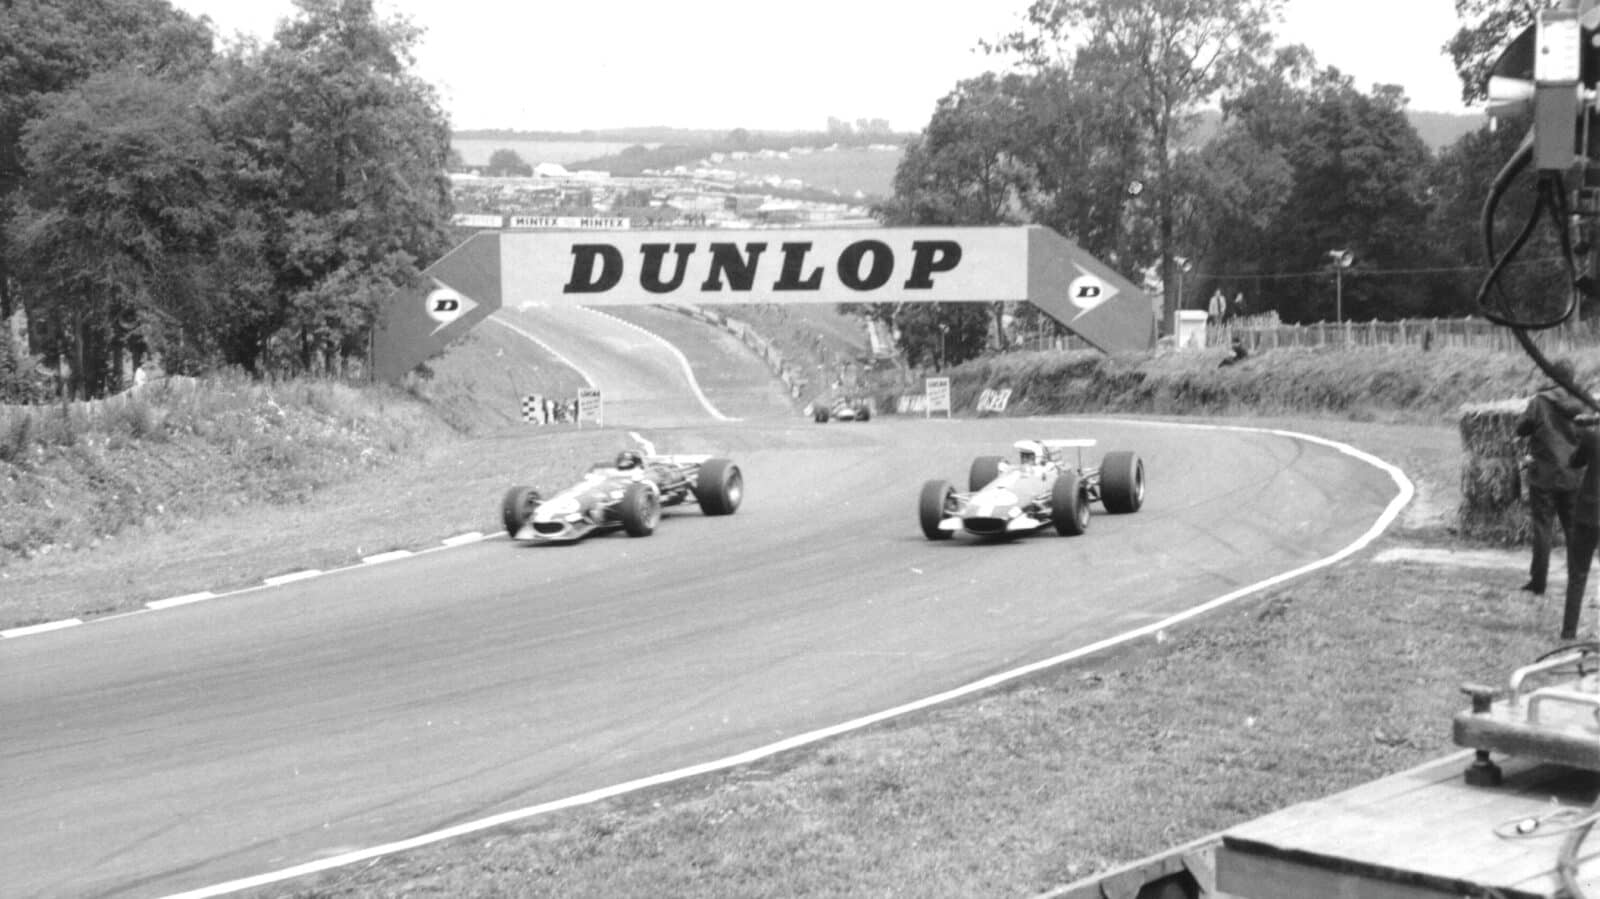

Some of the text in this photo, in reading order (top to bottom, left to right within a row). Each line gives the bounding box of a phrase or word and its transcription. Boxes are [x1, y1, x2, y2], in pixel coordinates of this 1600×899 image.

[516, 217, 623, 228] MINTEX MINTEX
[563, 240, 962, 294] DUNLOP
[1077, 286, 1101, 298] D
[433, 299, 459, 312] D
